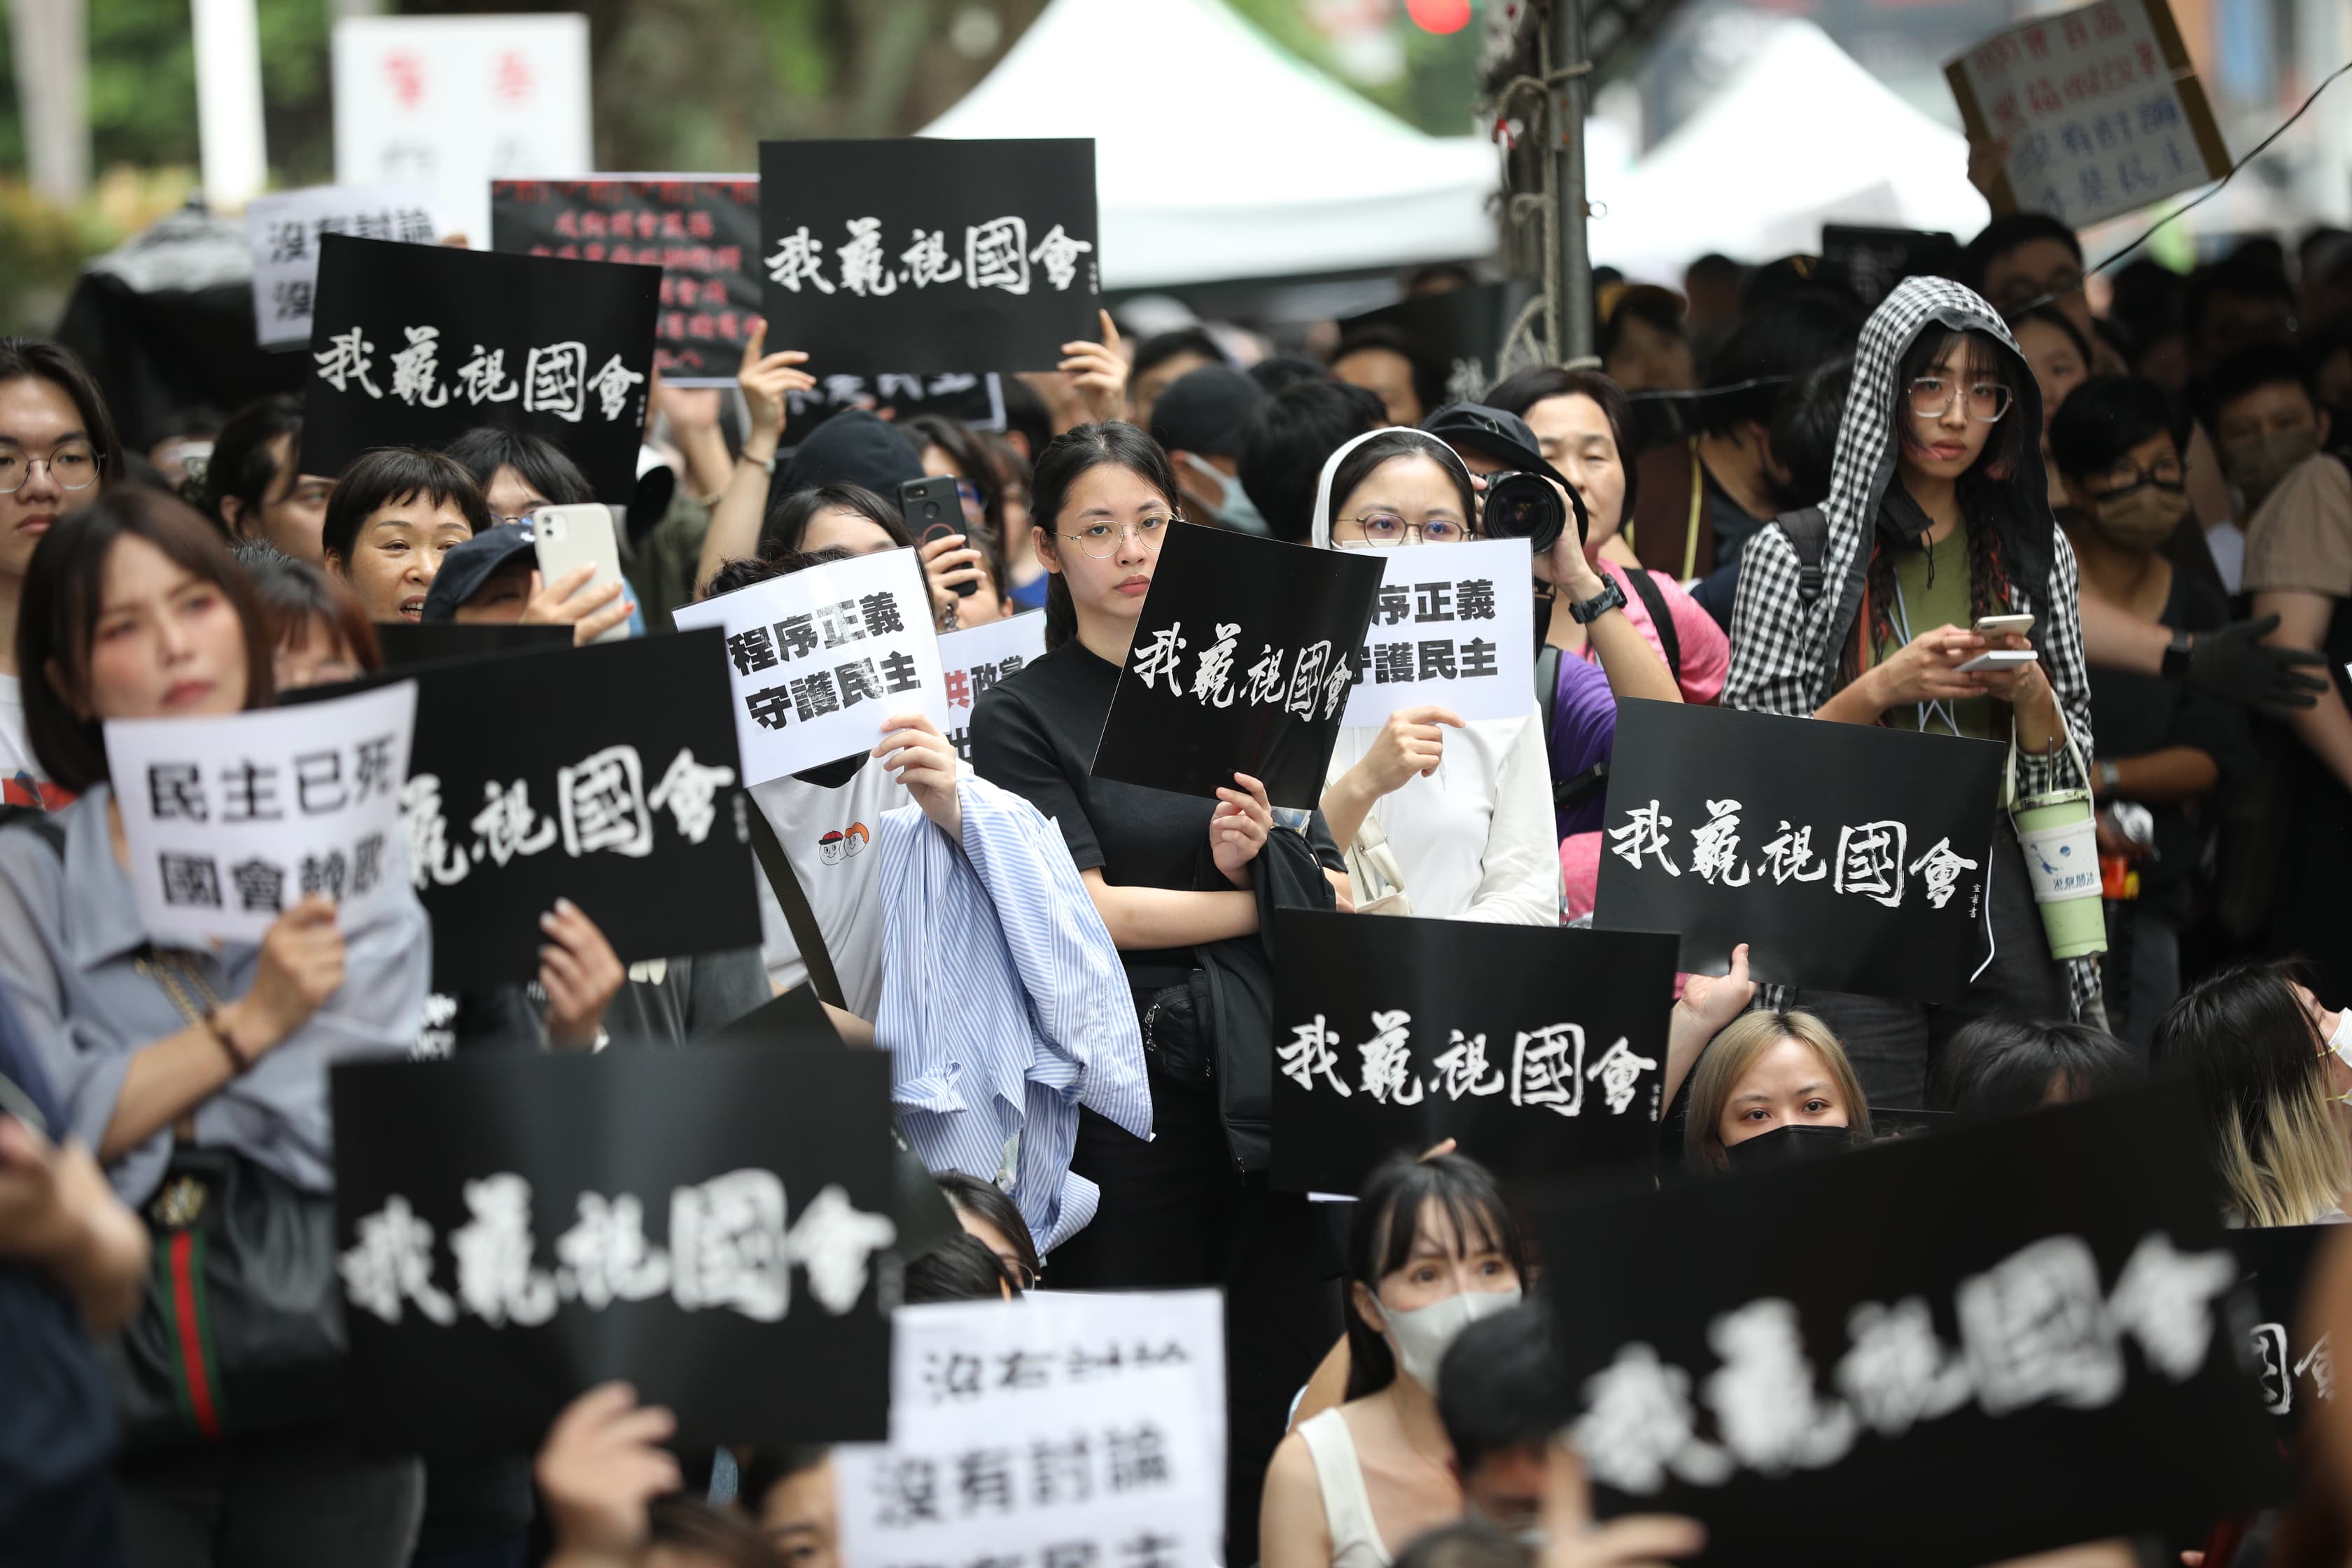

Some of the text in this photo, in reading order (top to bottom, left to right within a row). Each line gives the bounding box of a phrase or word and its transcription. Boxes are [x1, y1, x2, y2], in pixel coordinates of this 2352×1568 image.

[764, 216, 1093, 296] 我藐視國會
[314, 326, 645, 422] 我藐視國會
[727, 591, 904, 676] 程序正義
[1133, 622, 1352, 722] 我藐視國會
[745, 650, 922, 731] 守護民主
[146, 732, 395, 824] 民主已死
[1608, 799, 1978, 909] 我藐視國會
[1276, 1009, 1657, 1116] 我藐視國會
